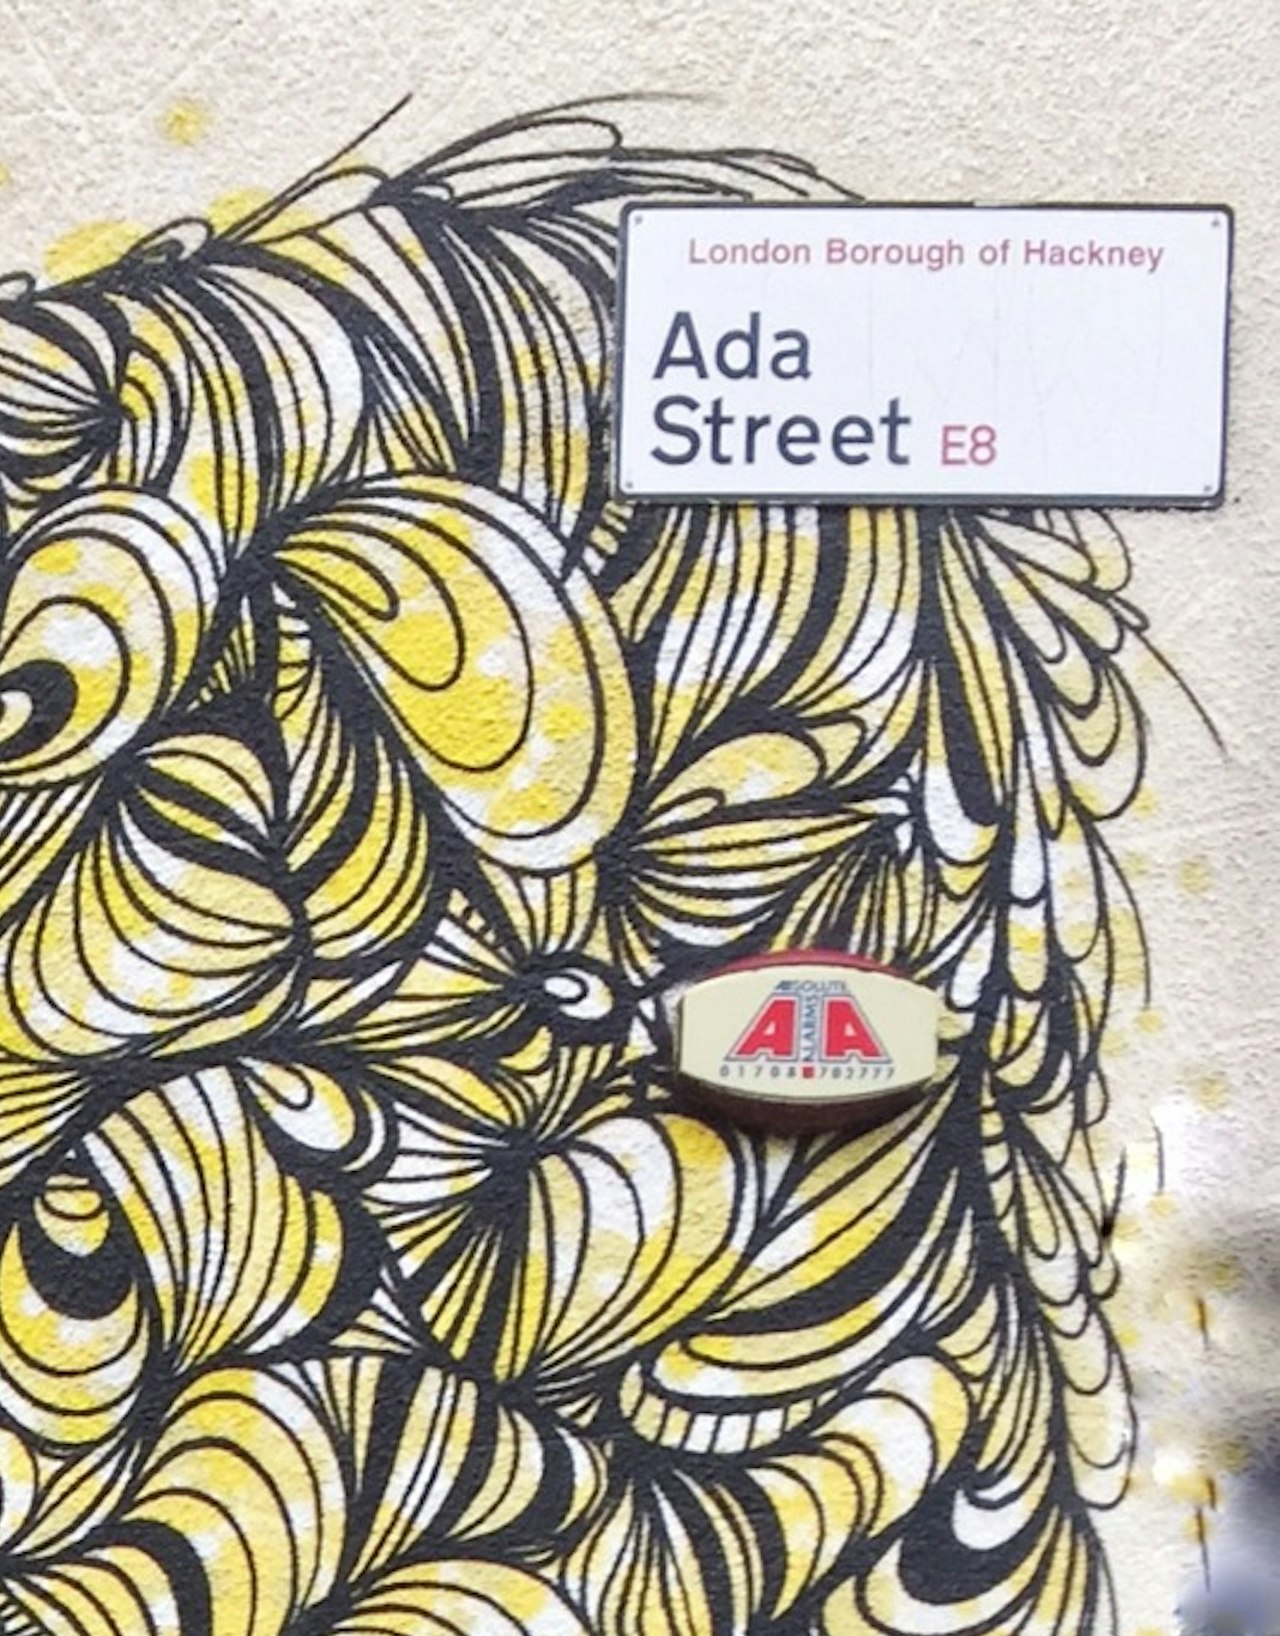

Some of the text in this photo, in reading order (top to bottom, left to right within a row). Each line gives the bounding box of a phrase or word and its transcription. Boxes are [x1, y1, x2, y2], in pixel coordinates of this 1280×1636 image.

[689, 239, 1165, 271] London Borough of Hackney
[653, 311, 812, 379] Ada
[651, 396, 998, 466] Street E8
